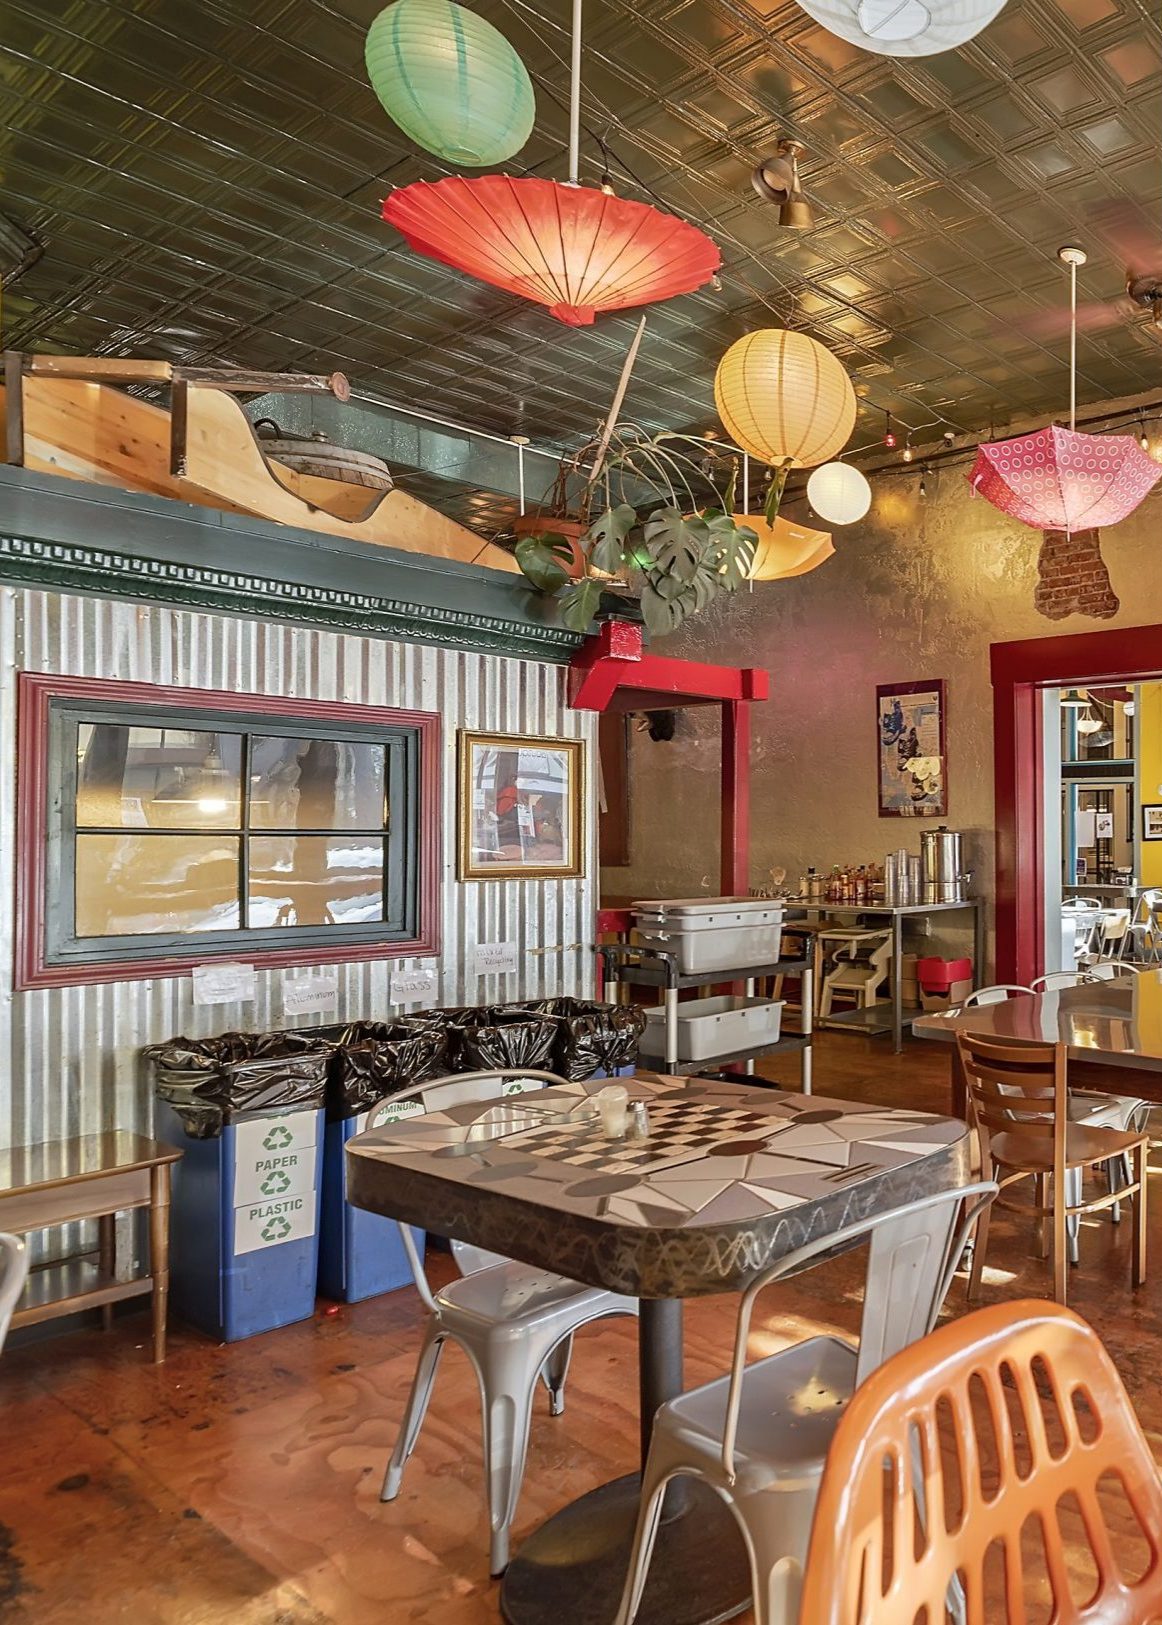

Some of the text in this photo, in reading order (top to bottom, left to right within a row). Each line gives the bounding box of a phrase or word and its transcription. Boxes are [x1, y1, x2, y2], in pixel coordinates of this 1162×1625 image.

[393, 980, 431, 992] Glass
[379, 1102, 417, 1115] UMINUM
[255, 1155, 298, 1172] PAPER
[249, 1199, 303, 1220] PLASTIC
